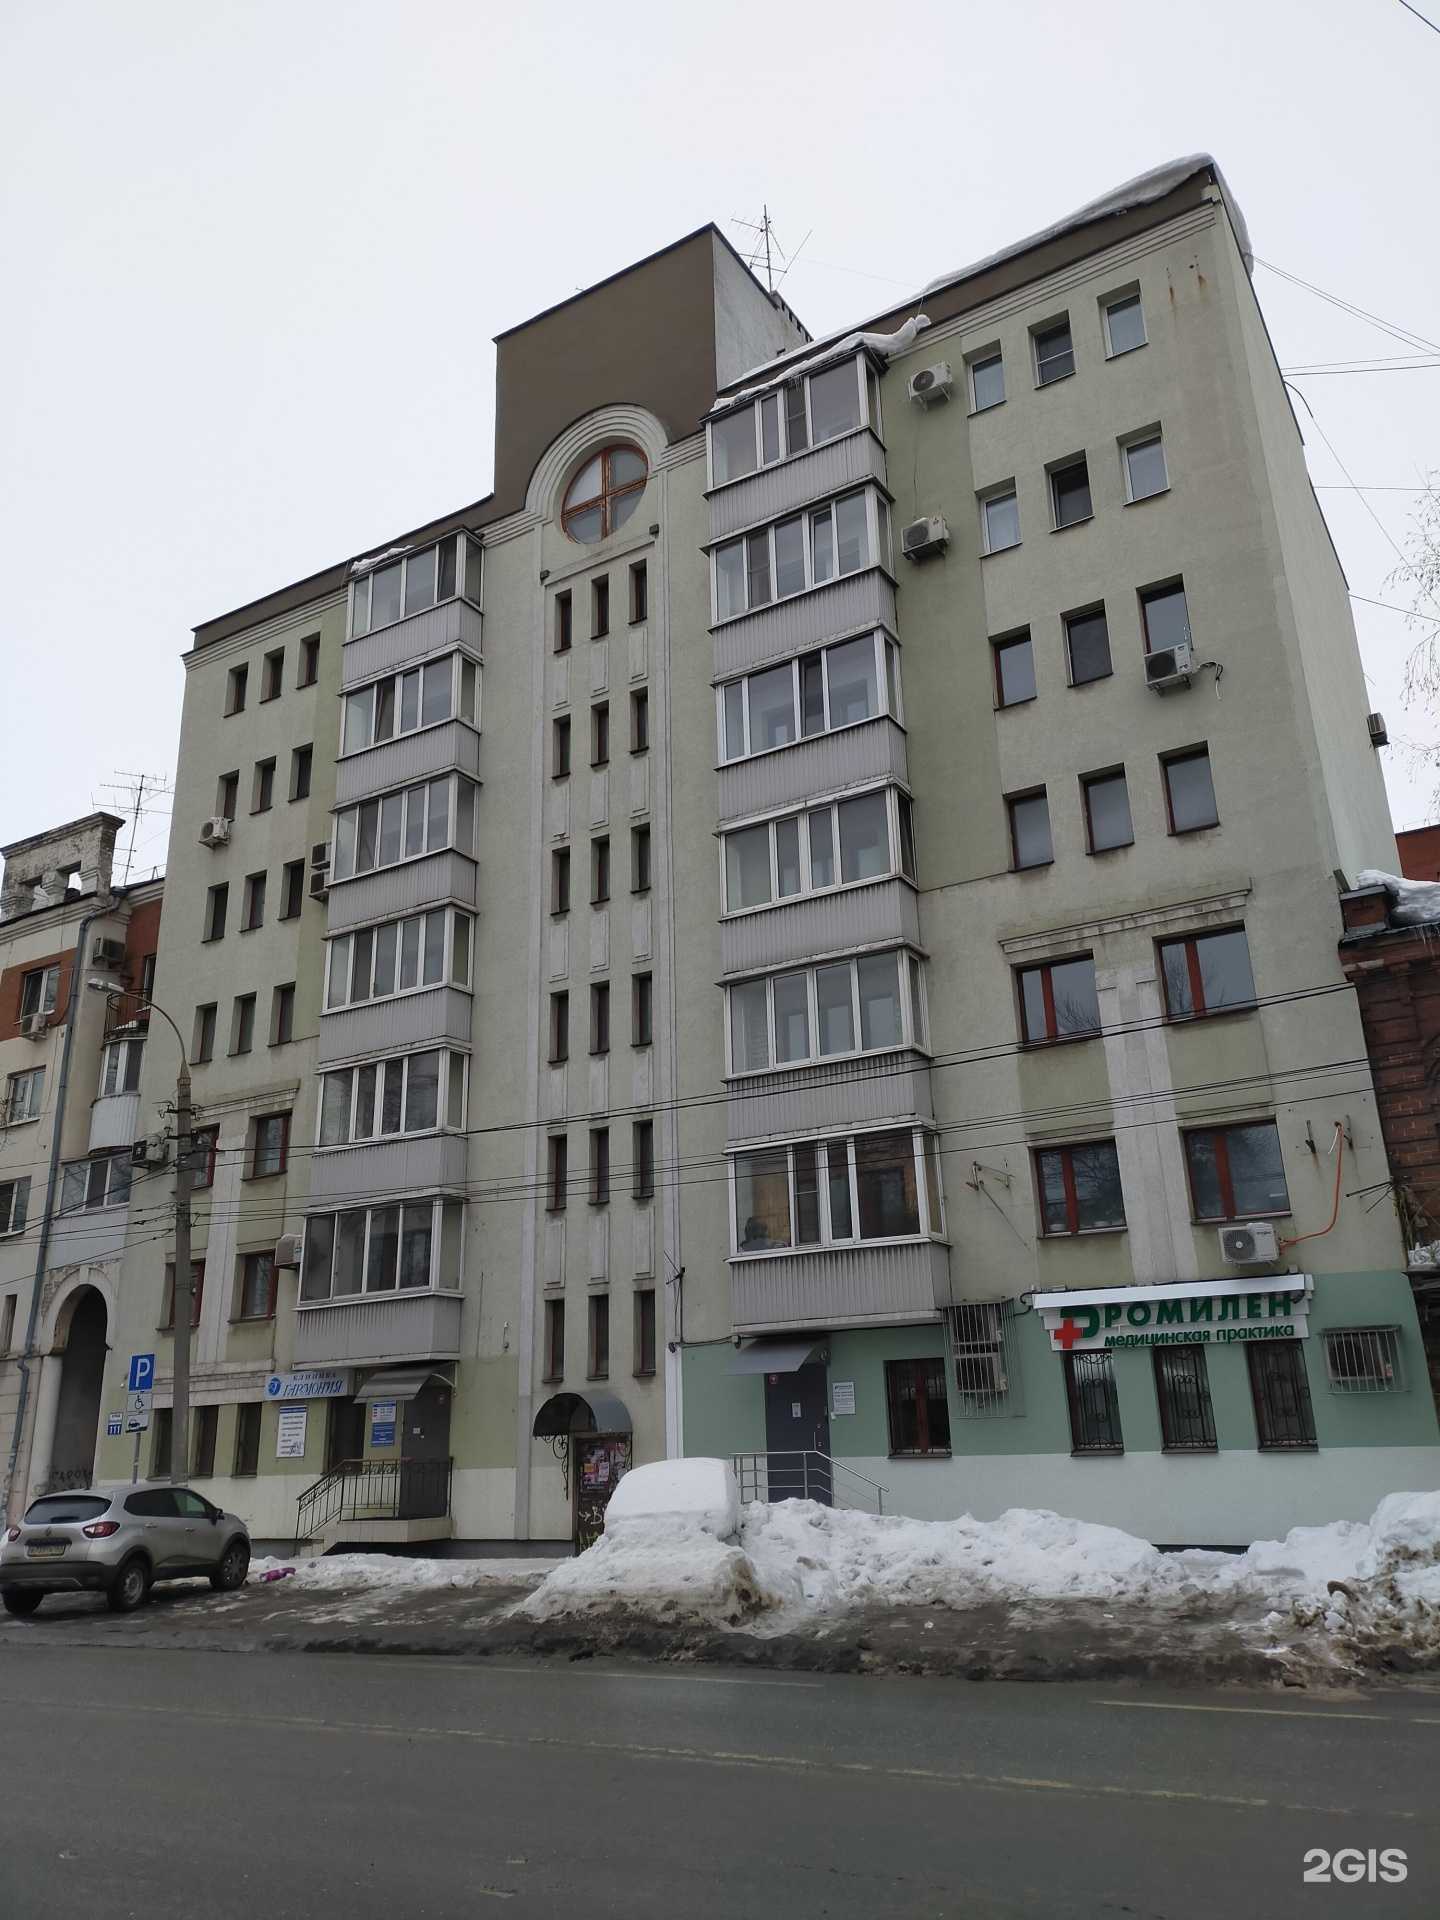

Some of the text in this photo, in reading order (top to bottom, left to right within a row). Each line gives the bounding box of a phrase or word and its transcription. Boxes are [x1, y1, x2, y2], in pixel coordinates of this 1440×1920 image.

[1104, 1325, 1295, 1347] медицинская практика
[283, 1379, 344, 1397] ГАРМОНИЯ
